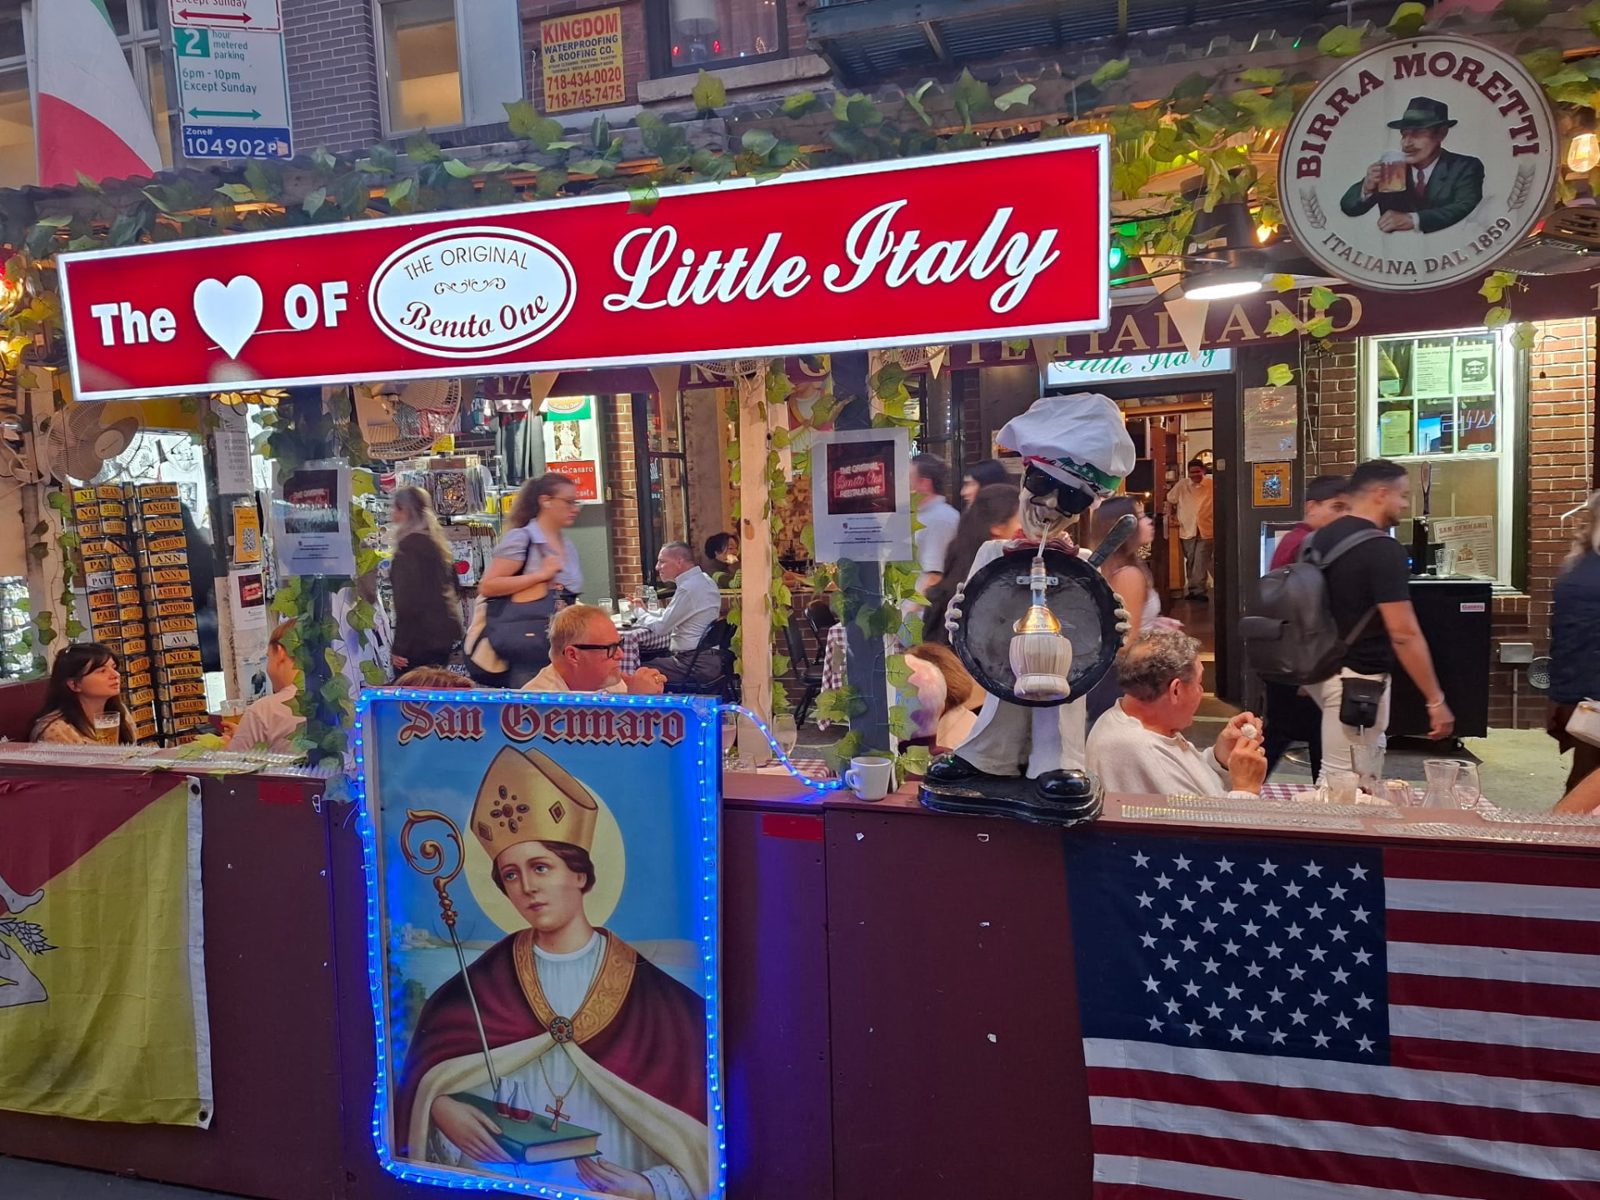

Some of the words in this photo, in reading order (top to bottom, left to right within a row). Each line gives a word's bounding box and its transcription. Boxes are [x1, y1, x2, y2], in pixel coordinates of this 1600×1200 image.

[543, 13, 619, 44] KINGDOM
[212, 31, 231, 39] hour
[184, 29, 202, 54] 2
[213, 41, 249, 50] metered
[544, 34, 619, 55] WATERPROOFING
[214, 51, 245, 61] parking
[549, 54, 556, 63] &
[558, 48, 597, 62] ROOFING
[599, 46, 615, 55] CO.
[182, 68, 205, 79] 6pm
[214, 69, 241, 80] 10pm
[546, 66, 622, 92] 718-434-0020
[184, 82, 218, 93] Except
[220, 82, 257, 94] Sunday
[547, 85, 623, 110] 718-745-7475
[1296, 69, 1385, 179] BIRRA
[1393, 51, 1541, 157] MORETTI
[186, 138, 267, 156] 104902
[1322, 232, 1418, 275] ITALIANA
[1424, 253, 1469, 273] DAL
[1468, 216, 1512, 255] 1859
[403, 254, 434, 281] THE
[440, 245, 529, 271] ORIGINAL
[91, 301, 177, 346] The
[284, 280, 349, 332] OF
[601, 223, 813, 313] Little
[823, 199, 1061, 314] Italy
[400, 301, 496, 338] Benito
[500, 295, 549, 331] One
[147, 502, 177, 511] ANGIE
[150, 520, 179, 529] ANITA
[155, 554, 181, 563] ANN
[158, 588, 188, 598] ASHLEY
[160, 602, 191, 612] ANTONIO
[161, 619, 193, 629] AUSTIN
[172, 636, 188, 644] AVA
[169, 653, 196, 661] NICK
[174, 683, 200, 693] BEN
[399, 699, 485, 744] San
[501, 700, 686, 745] Gennaro
